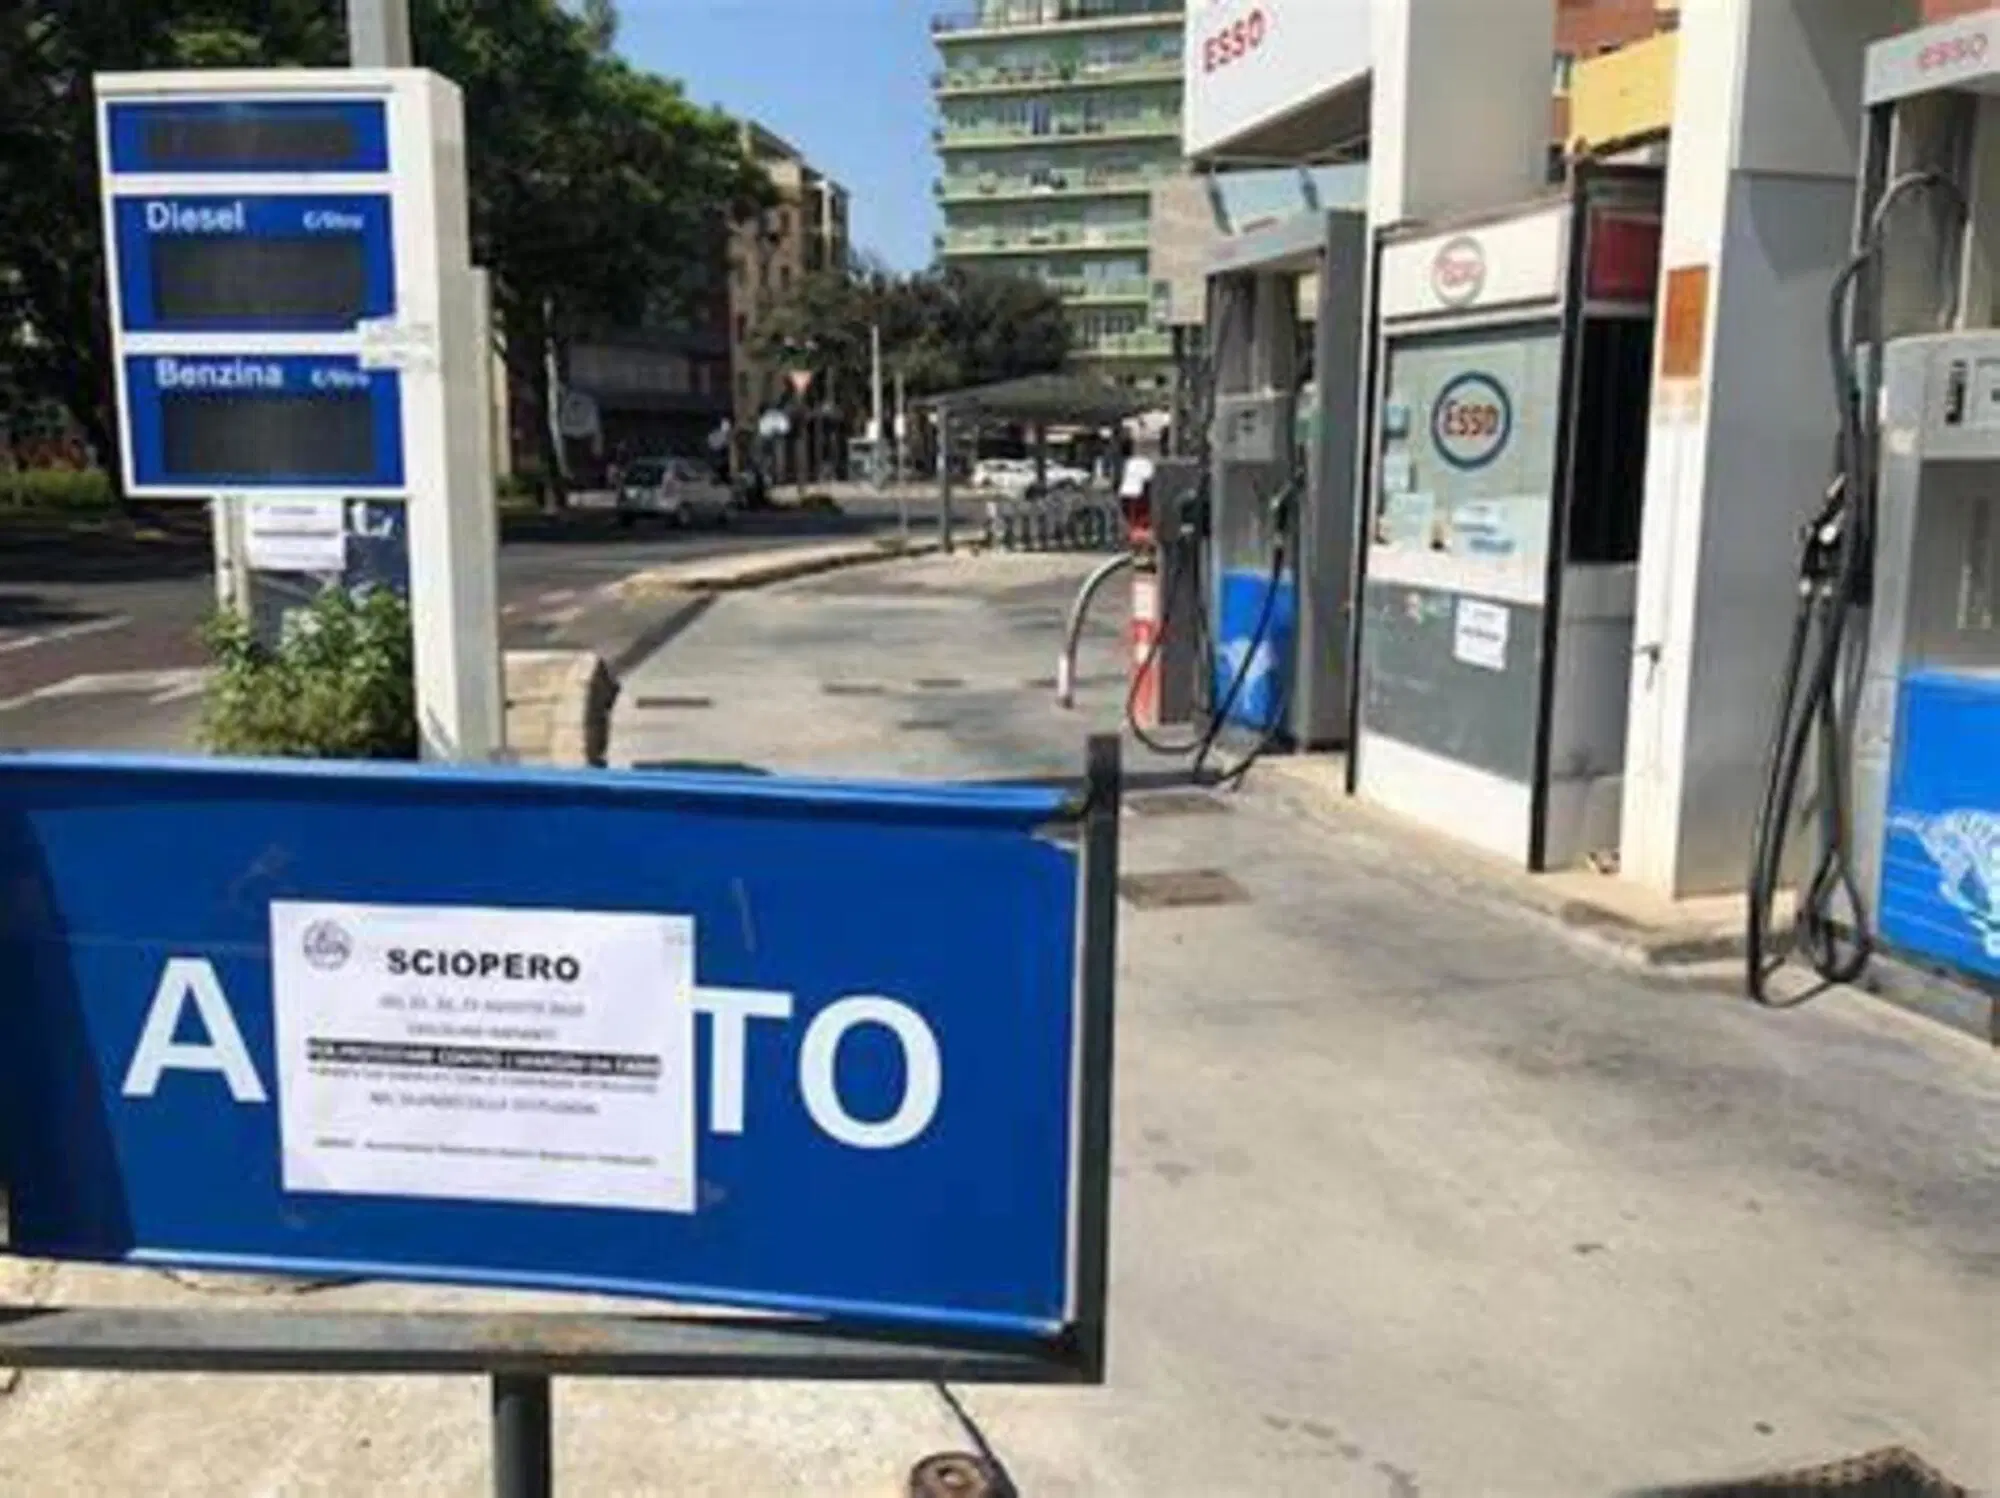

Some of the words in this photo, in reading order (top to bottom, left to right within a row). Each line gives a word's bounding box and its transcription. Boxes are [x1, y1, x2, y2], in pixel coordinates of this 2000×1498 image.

[146, 201, 244, 232] Diesel
[155, 358, 283, 388] Benzina
[386, 949, 580, 982] SCIOPERO
